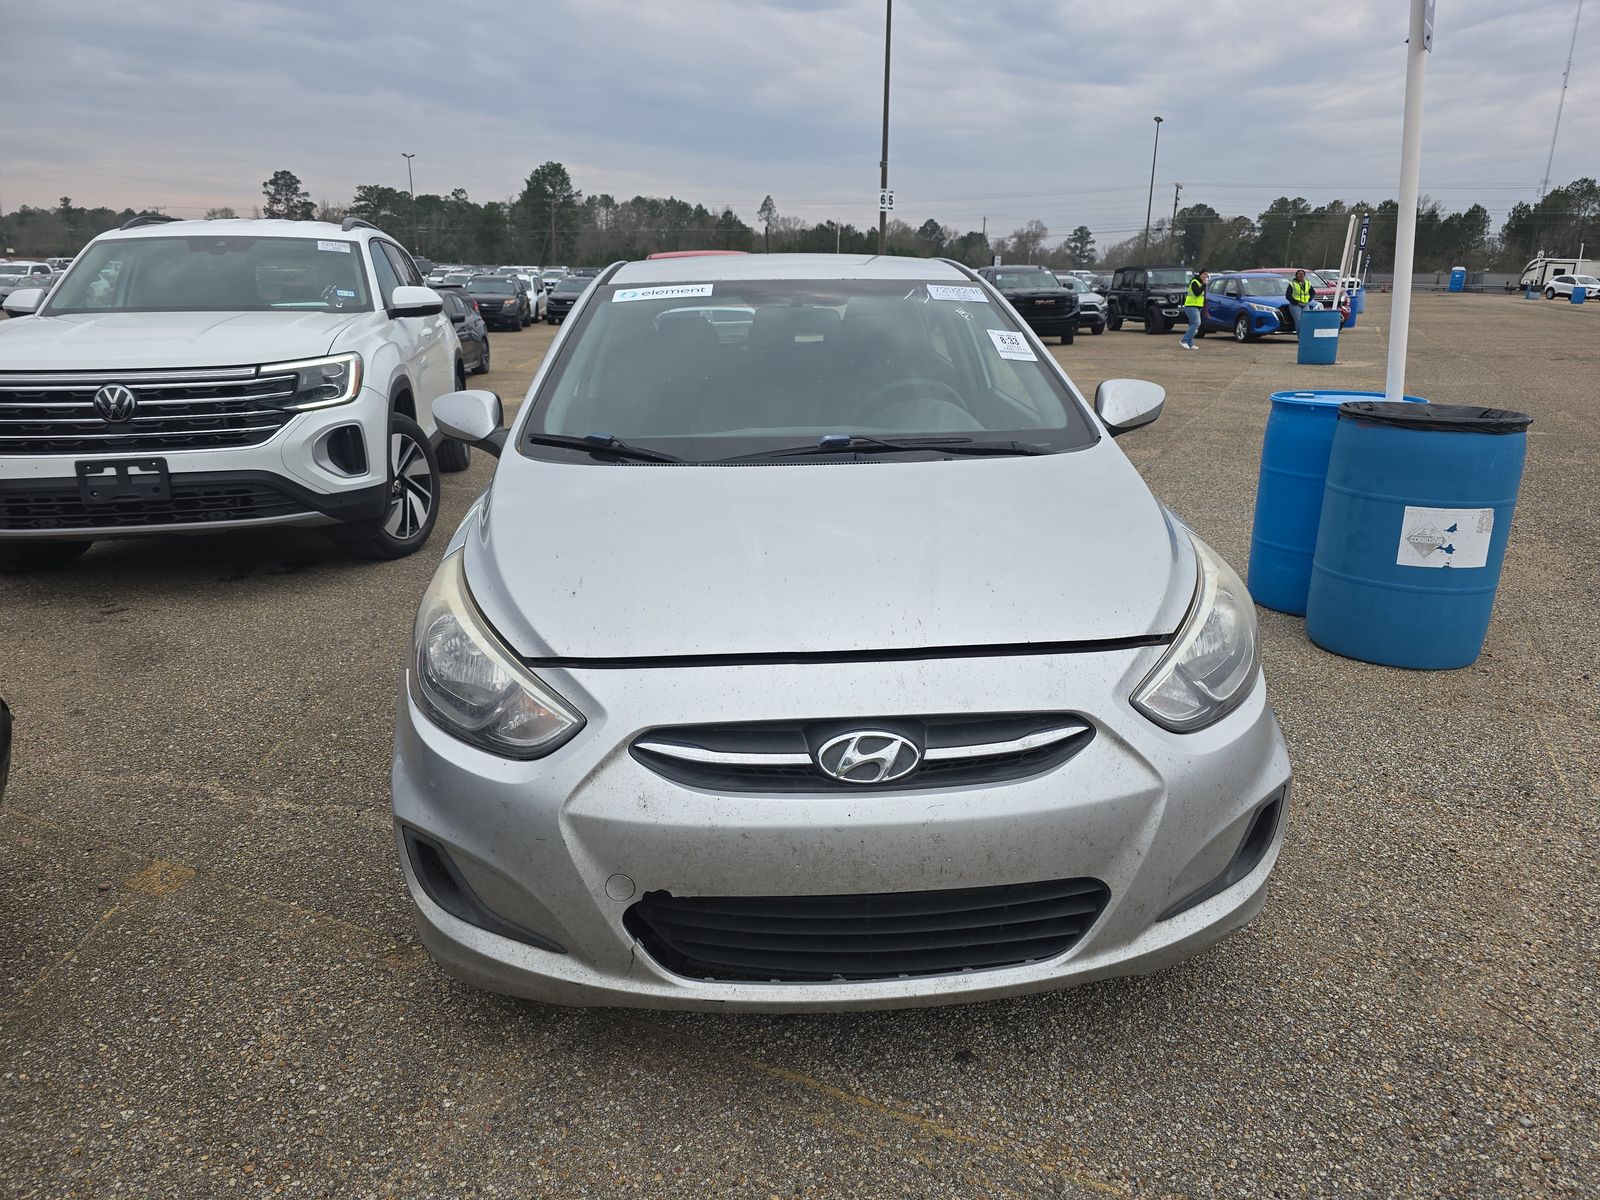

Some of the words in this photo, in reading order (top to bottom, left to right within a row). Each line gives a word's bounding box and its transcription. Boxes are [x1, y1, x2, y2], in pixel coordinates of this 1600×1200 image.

[880, 194, 886, 205] 6
[888, 195, 894, 206] 5
[1360, 227, 1368, 246] 6
[641, 287, 706, 297] element
[999, 336, 1020, 346] 8:33
